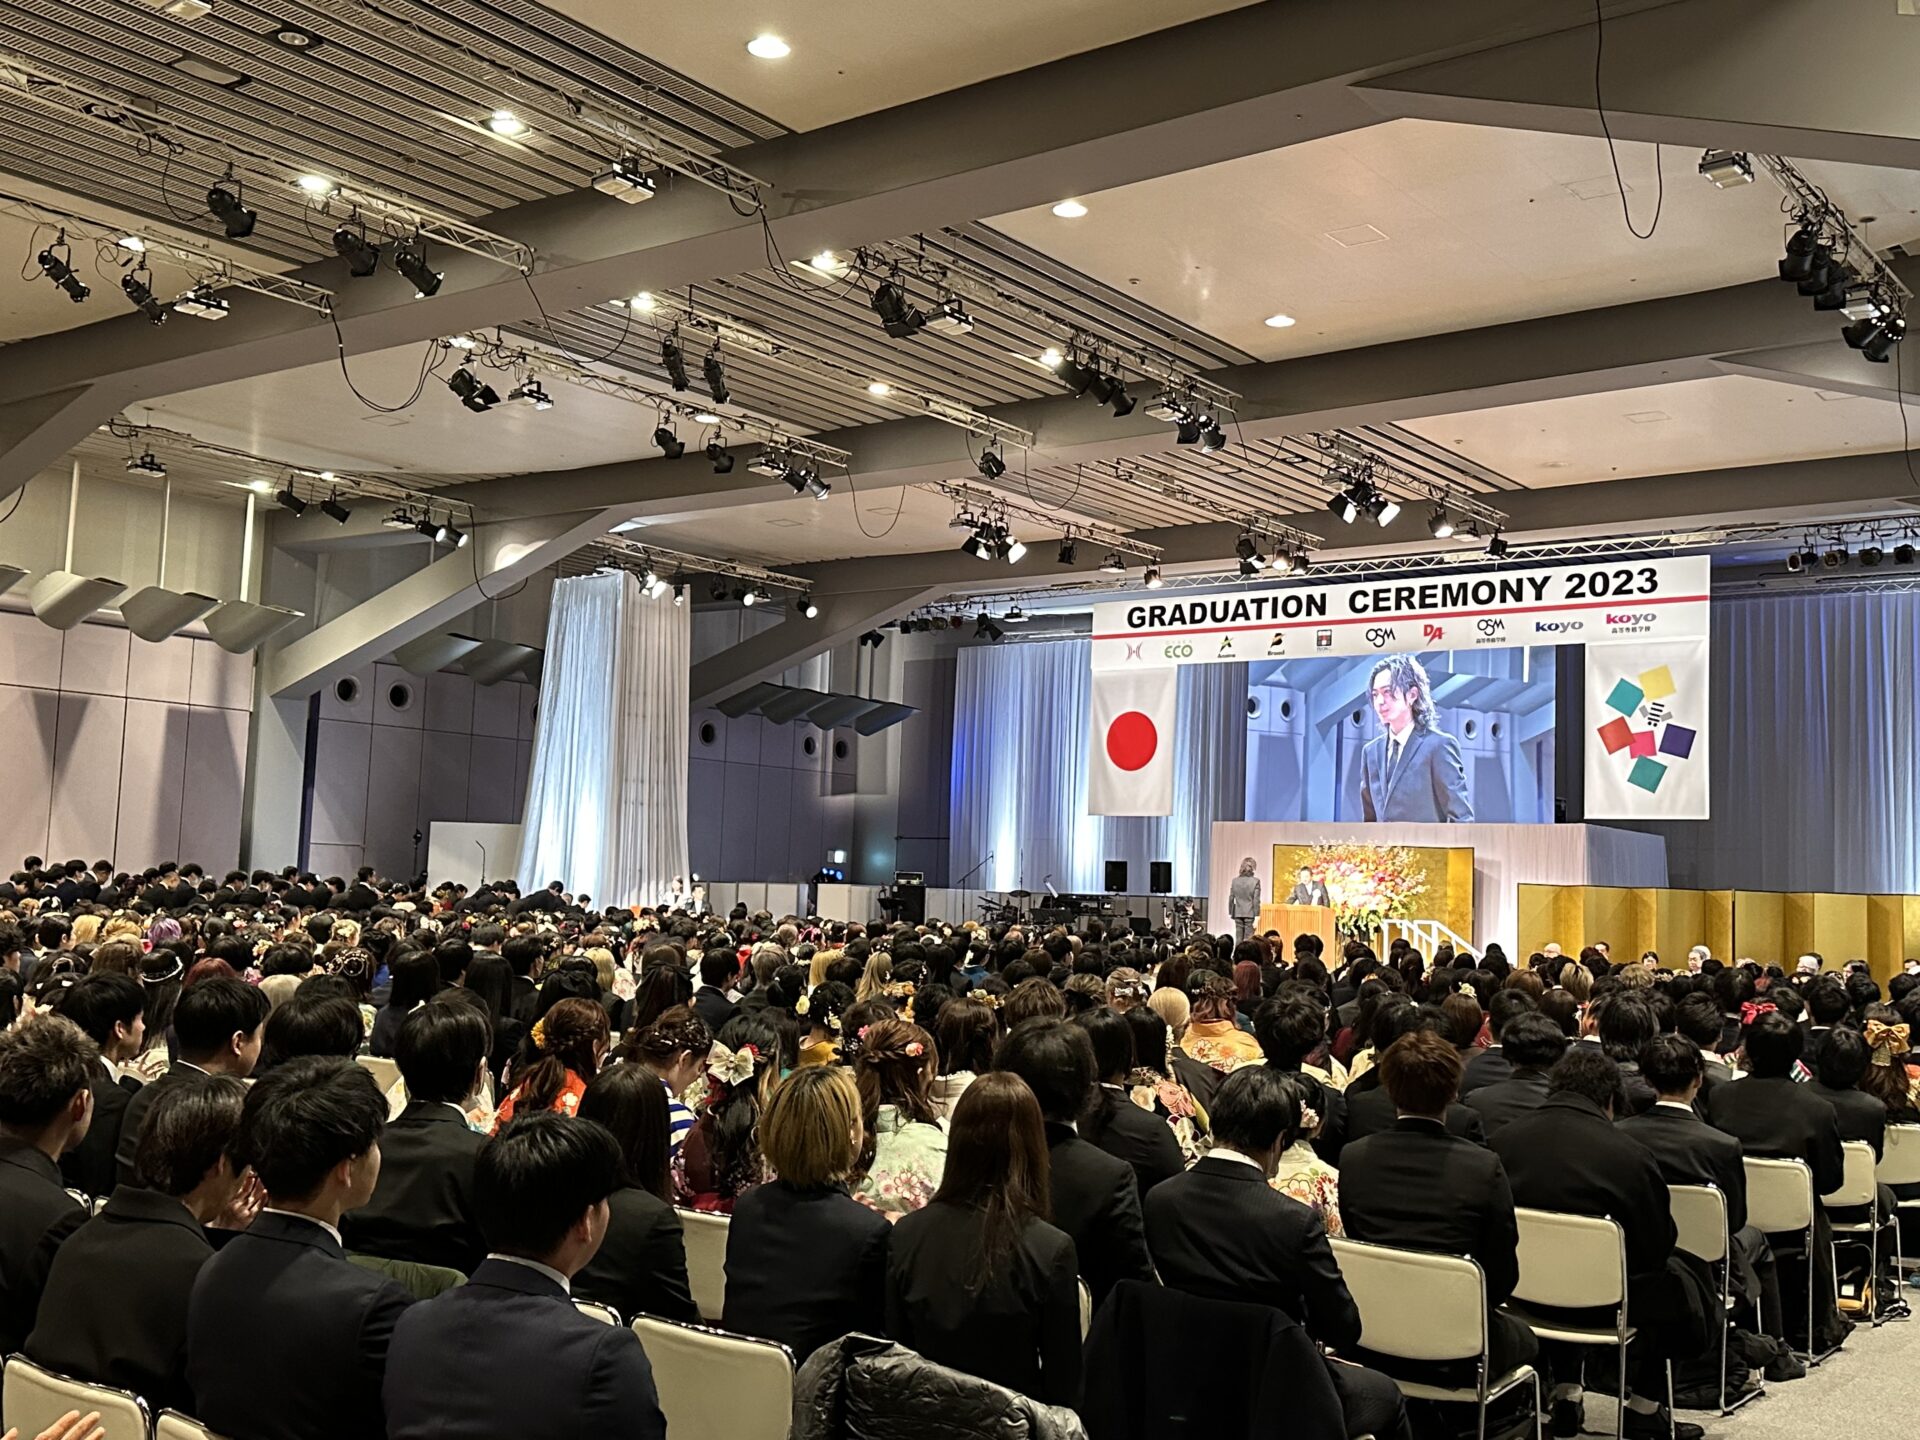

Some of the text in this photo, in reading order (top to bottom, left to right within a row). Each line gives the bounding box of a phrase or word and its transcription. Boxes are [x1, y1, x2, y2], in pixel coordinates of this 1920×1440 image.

[1127, 567, 1658, 629] GRADUATION CEREMONY 2023
[1605, 613, 1657, 625] koyo
[1535, 621, 1584, 634] koyo
[1164, 644, 1194, 659] ECO
